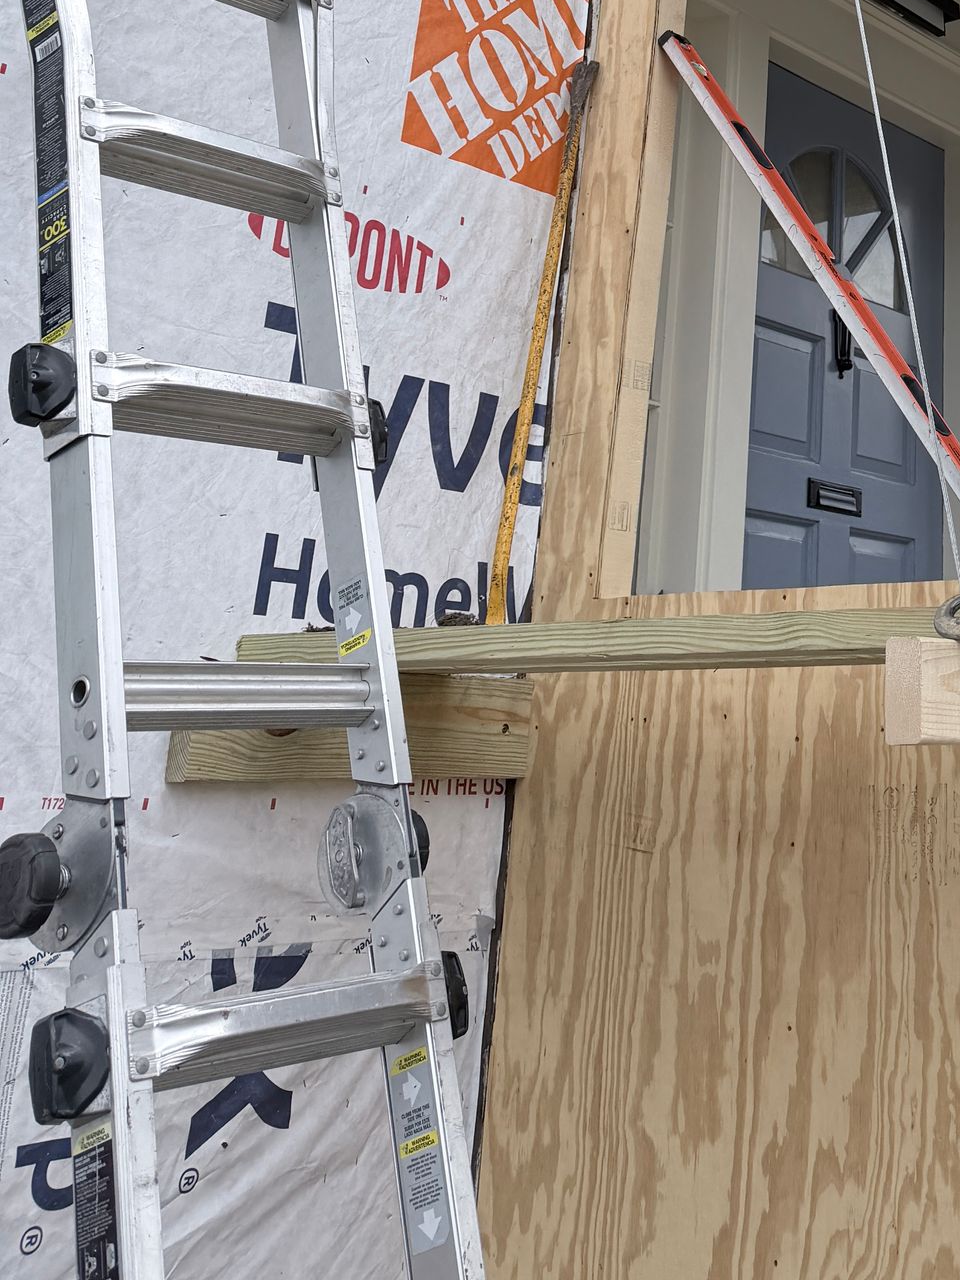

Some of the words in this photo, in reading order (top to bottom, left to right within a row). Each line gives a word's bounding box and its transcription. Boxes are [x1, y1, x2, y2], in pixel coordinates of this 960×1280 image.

[487, 76, 573, 180] DEP
[44, 215, 67, 241] 300
[420, 778, 440, 796] IN
[447, 778, 478, 796] THE
[483, 778, 506, 796] US
[41, 798, 65, 811] T172
[238, 922, 269, 947] Tyvek
